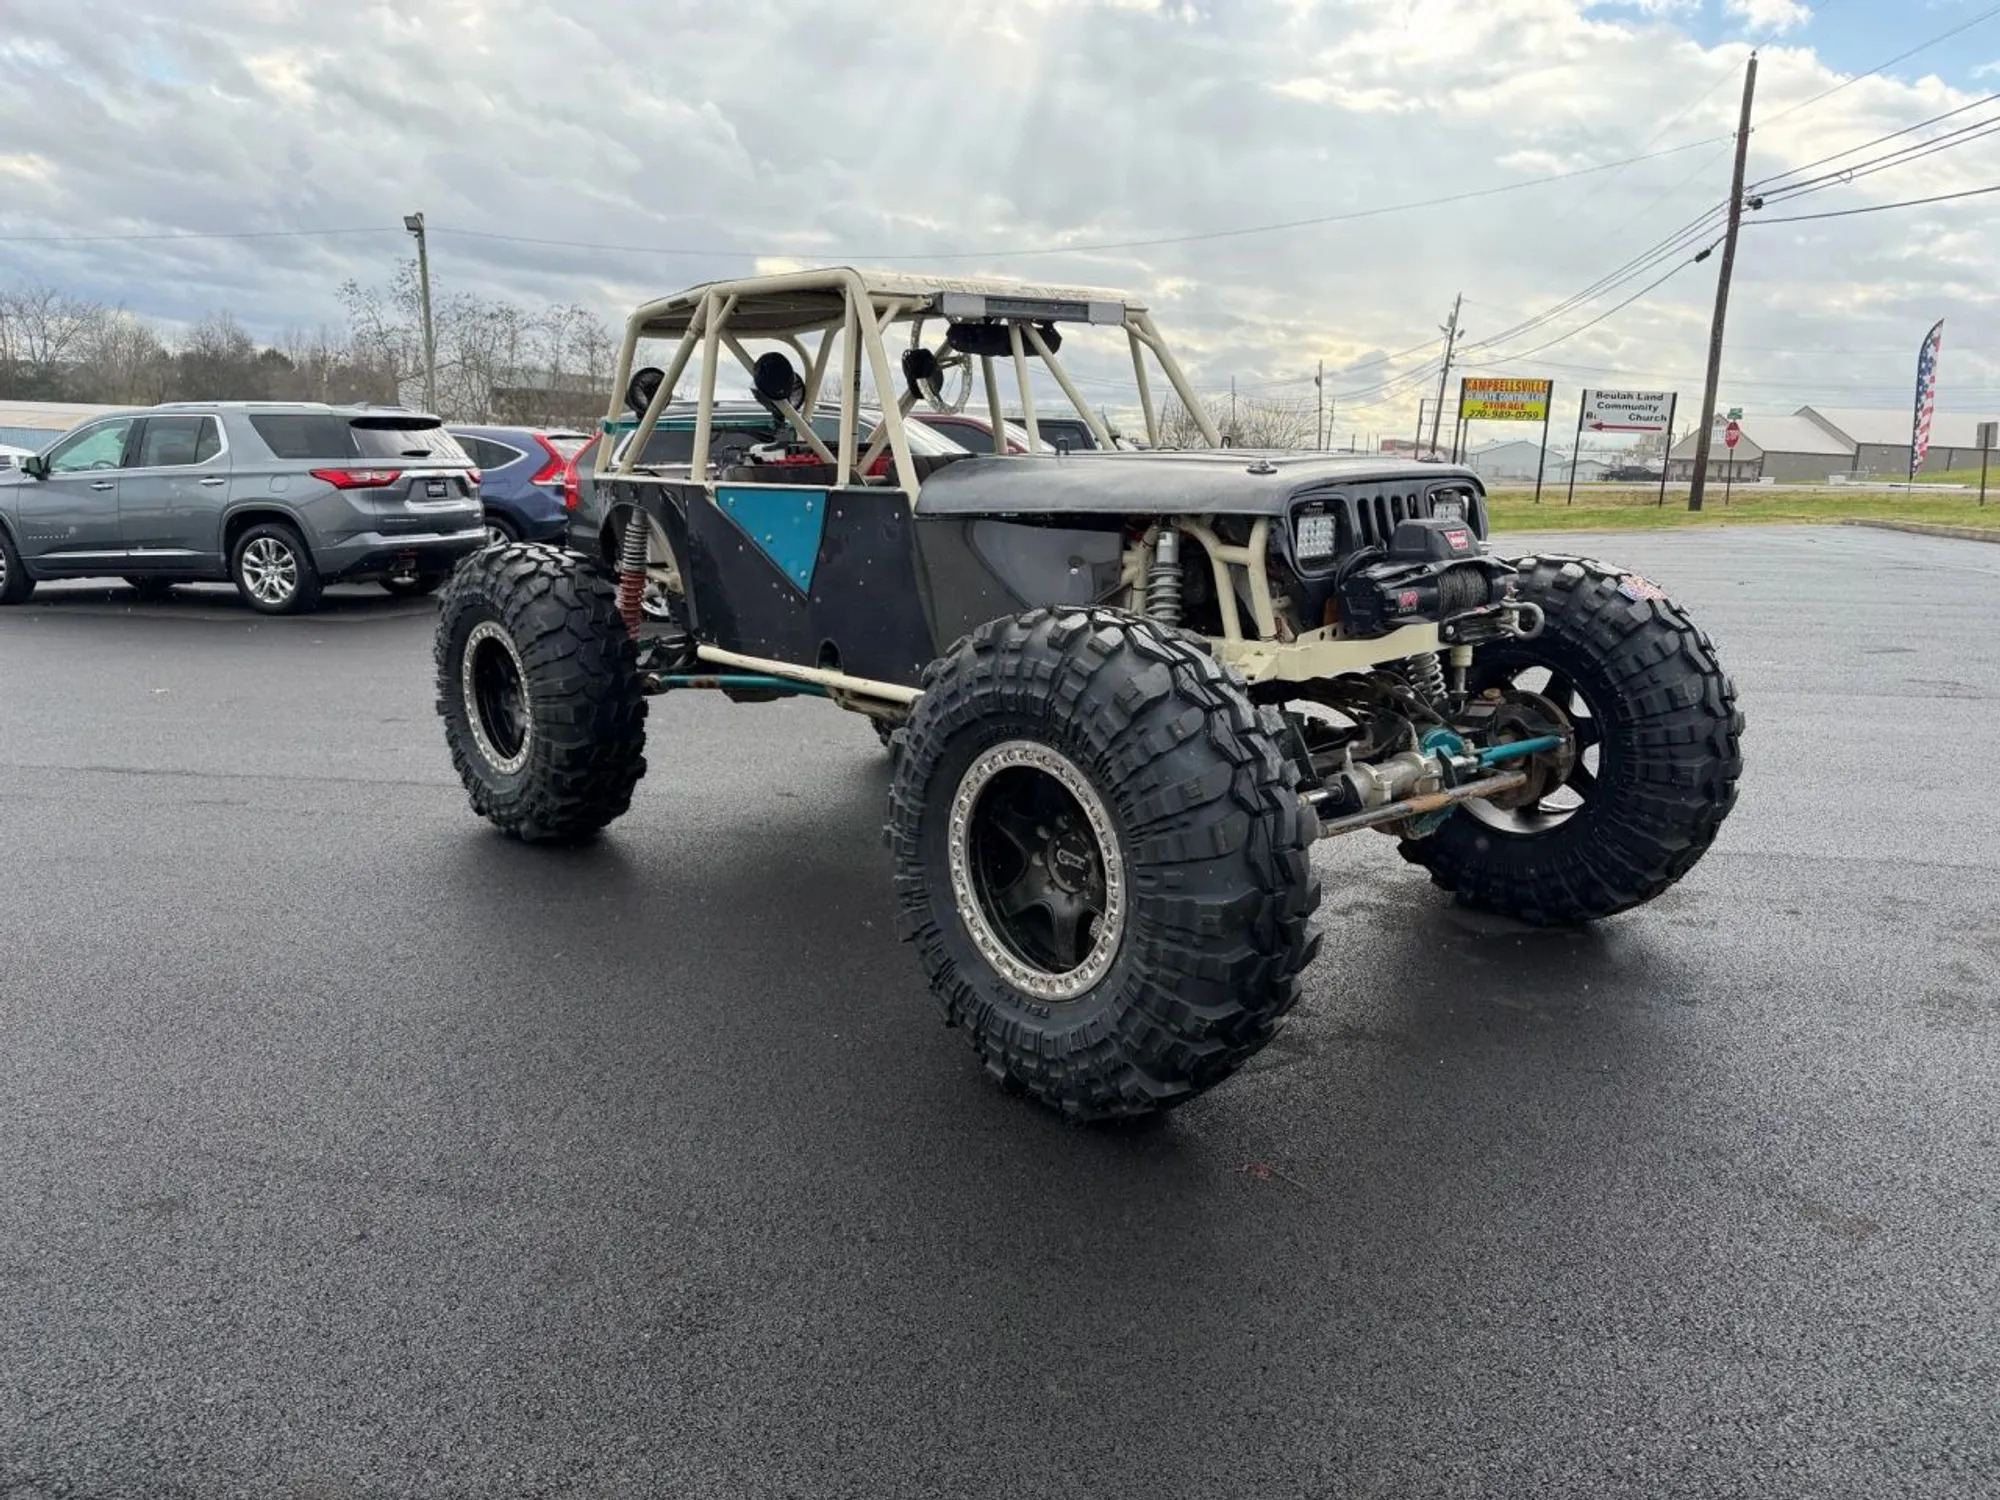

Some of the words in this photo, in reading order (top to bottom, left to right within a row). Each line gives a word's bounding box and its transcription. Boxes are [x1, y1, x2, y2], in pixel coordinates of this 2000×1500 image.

[1466, 380, 1546, 392] CAMPBELLSVILLE
[1596, 391, 1634, 400] Beulah
[1636, 392, 1664, 401] Land
[1481, 402, 1526, 410] STORAGE
[1597, 402, 1659, 413] Community
[1628, 412, 1667, 422] Church
